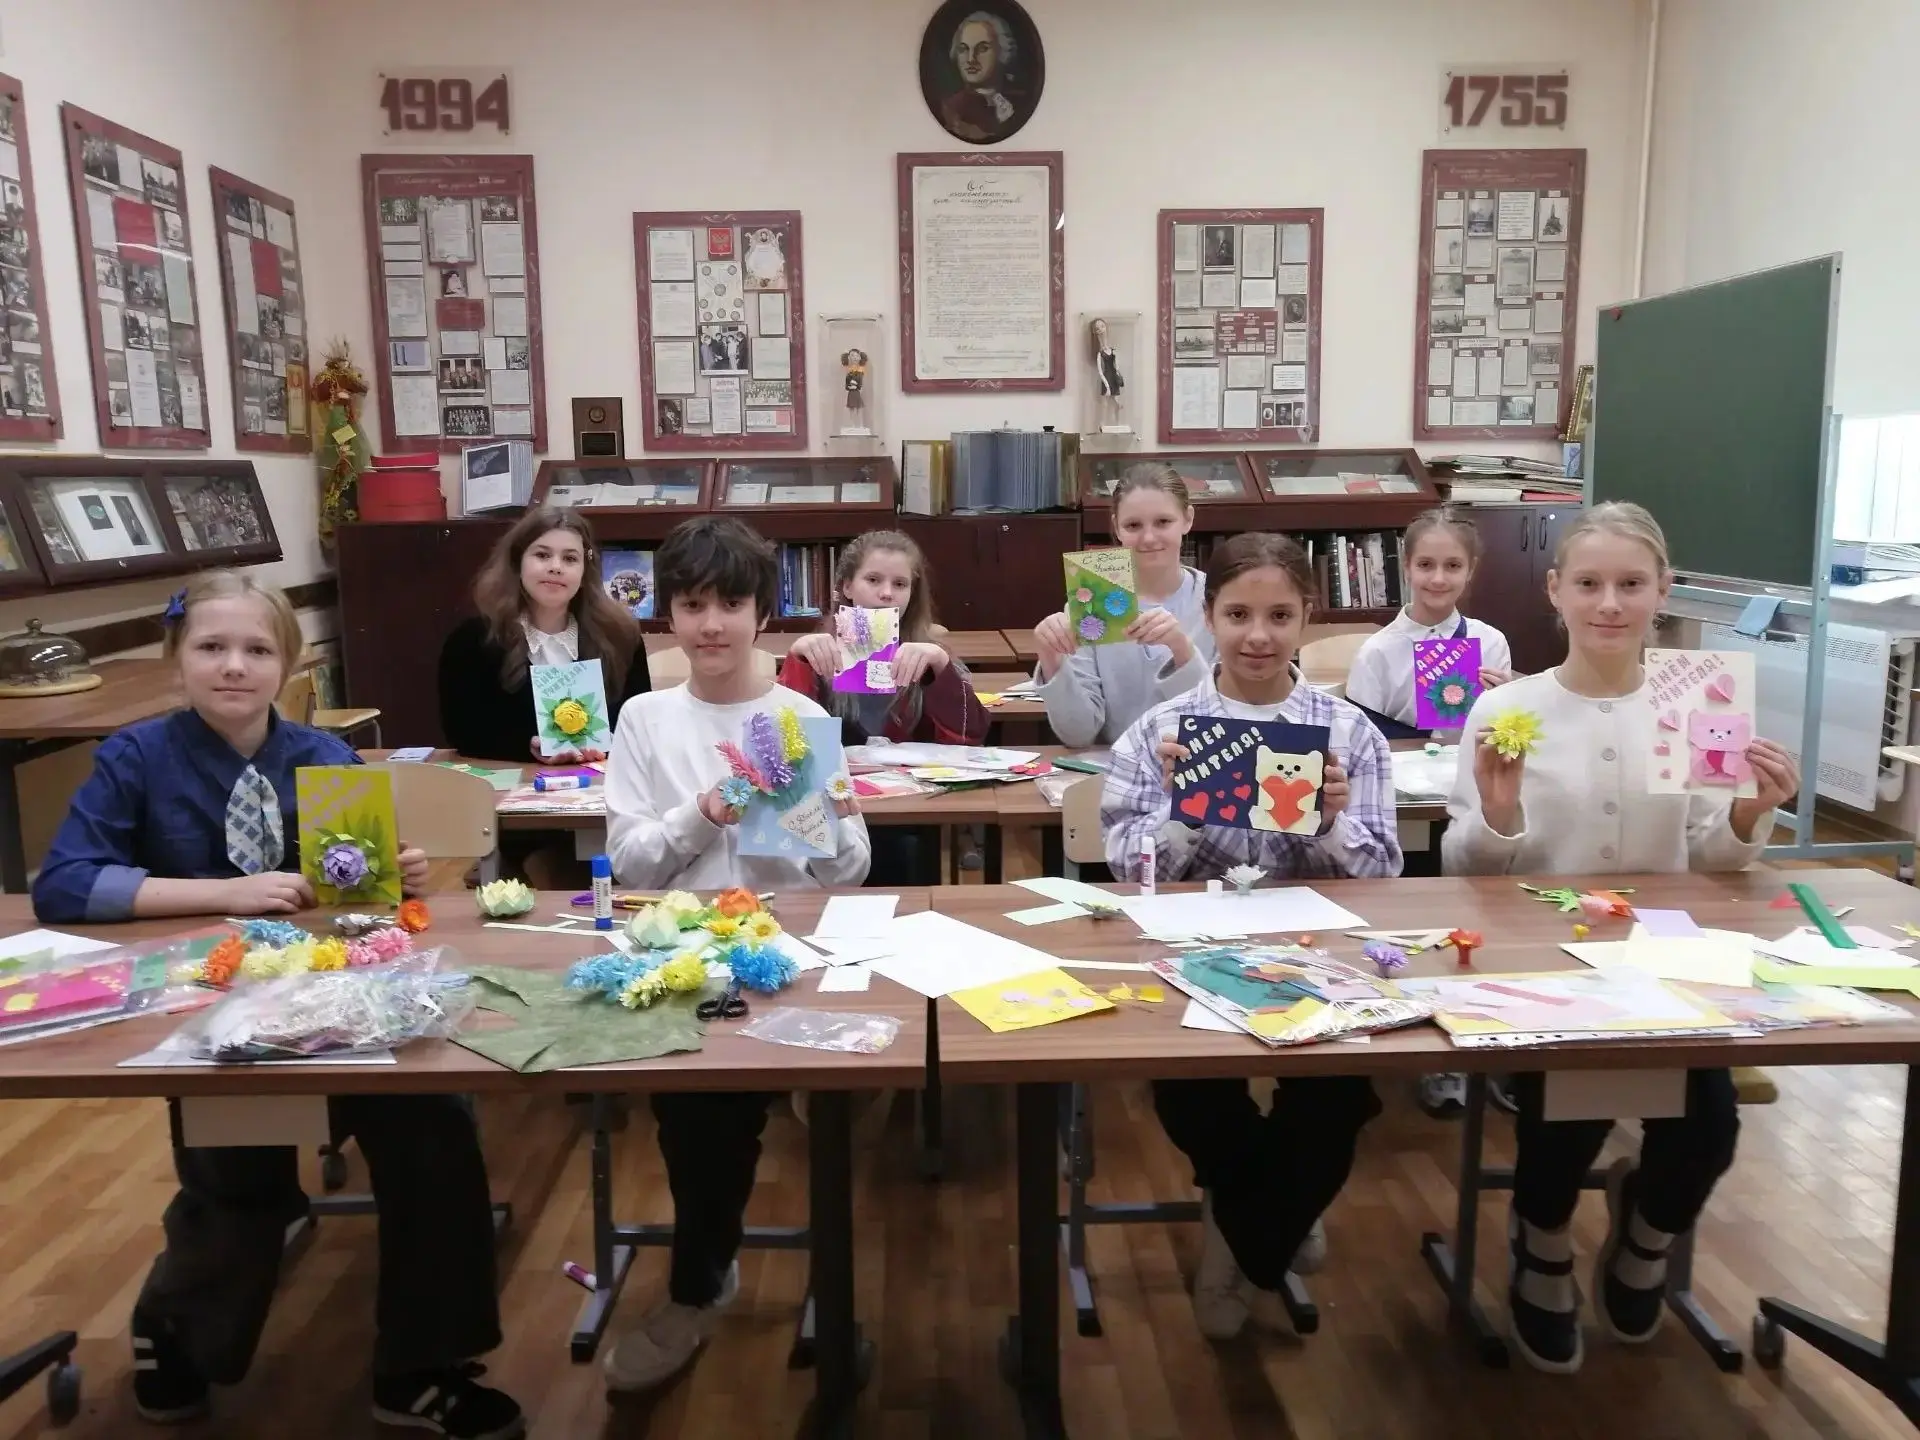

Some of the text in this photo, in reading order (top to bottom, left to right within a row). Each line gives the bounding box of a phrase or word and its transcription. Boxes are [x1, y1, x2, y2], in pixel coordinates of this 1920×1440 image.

[380, 78, 509, 131] 1994
[1444, 75, 1569, 127] 1755
[1414, 642, 1425, 652] С
[1648, 652, 1661, 664] С
[1184, 718, 1197, 731] С
[1174, 726, 1264, 790] УЧИТЕЛЯ!
